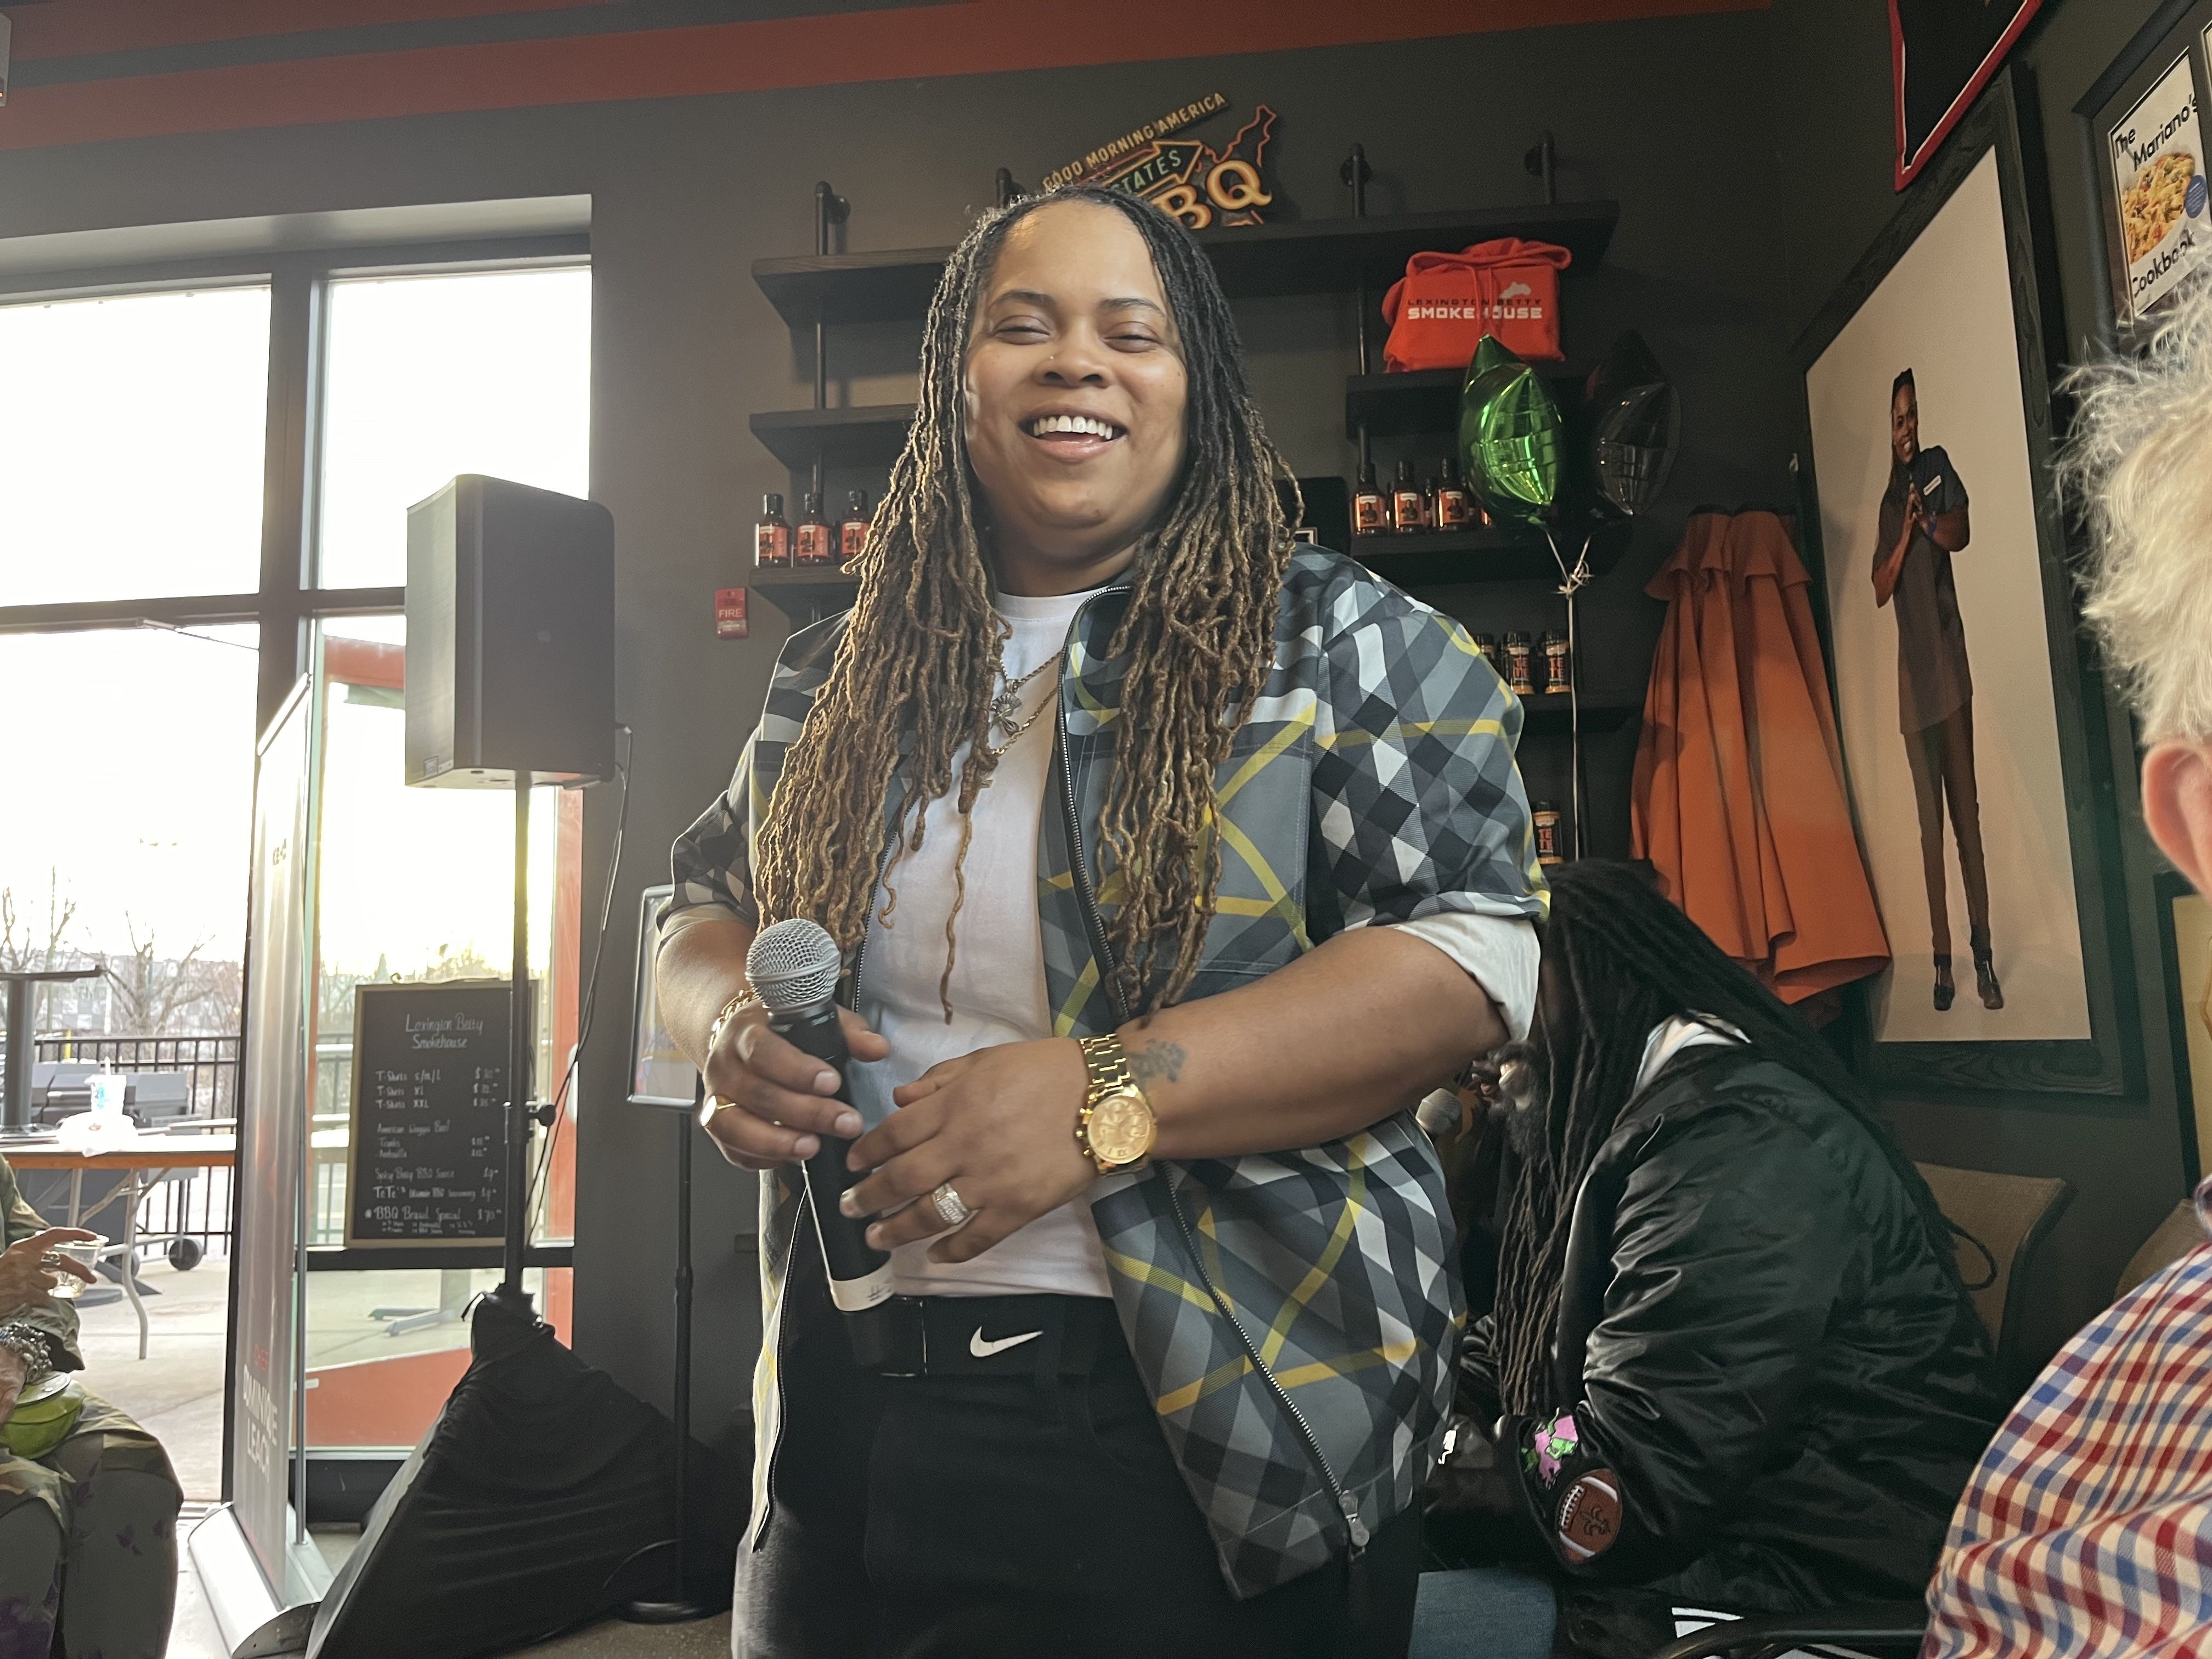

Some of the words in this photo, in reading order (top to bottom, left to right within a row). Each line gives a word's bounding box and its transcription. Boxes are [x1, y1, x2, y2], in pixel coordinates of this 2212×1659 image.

[1042, 161, 1084, 190] GOOD
[1086, 127, 1154, 168] MORNING
[1158, 92, 1226, 133] AMERICA
[2114, 128, 2136, 159] The
[1112, 149, 1181, 195] TATES
[719, 608, 743, 618] FIRE
[373, 1205, 399, 1220] BBQ
